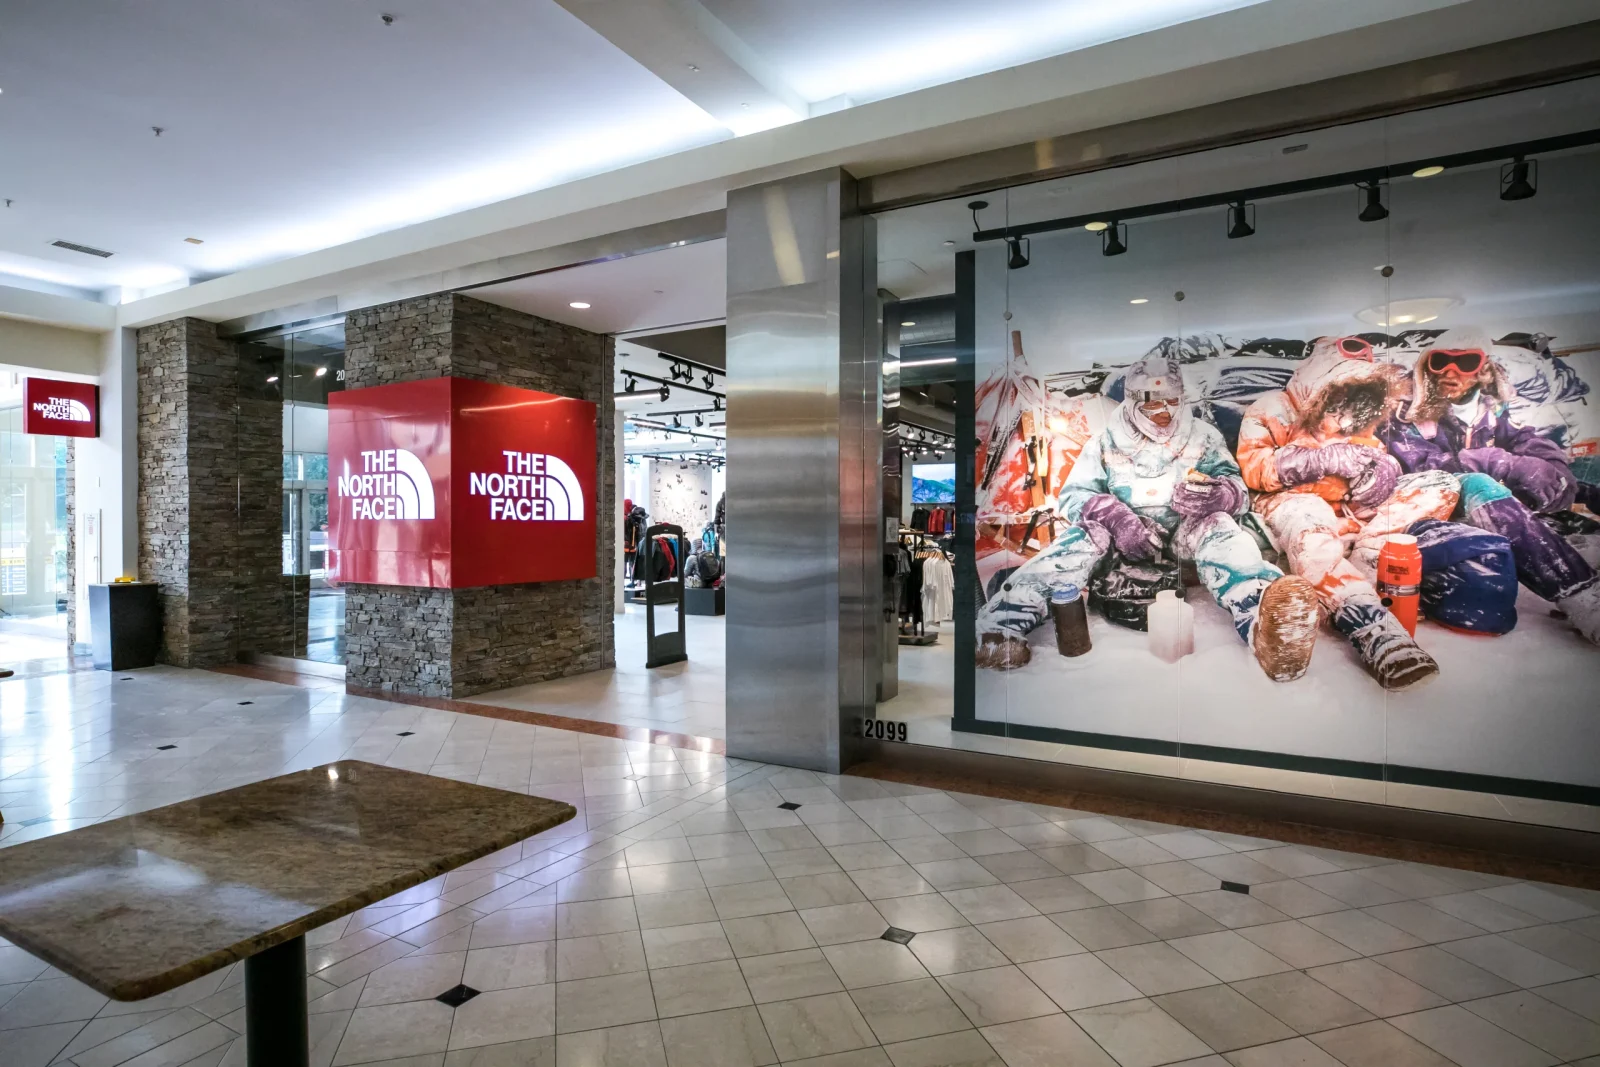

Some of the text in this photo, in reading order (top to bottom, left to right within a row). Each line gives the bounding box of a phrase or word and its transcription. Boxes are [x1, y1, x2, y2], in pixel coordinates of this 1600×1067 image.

[33, 403, 70, 413] NORTH
[48, 397, 70, 406] THE
[43, 411, 70, 420] FACE
[361, 449, 396, 473] THE
[503, 450, 545, 475] THE
[338, 473, 396, 497] NORTH
[470, 472, 545, 498] NORTH
[352, 497, 396, 520] FACE
[491, 498, 545, 521] FACE
[864, 719, 907, 741] 2099
